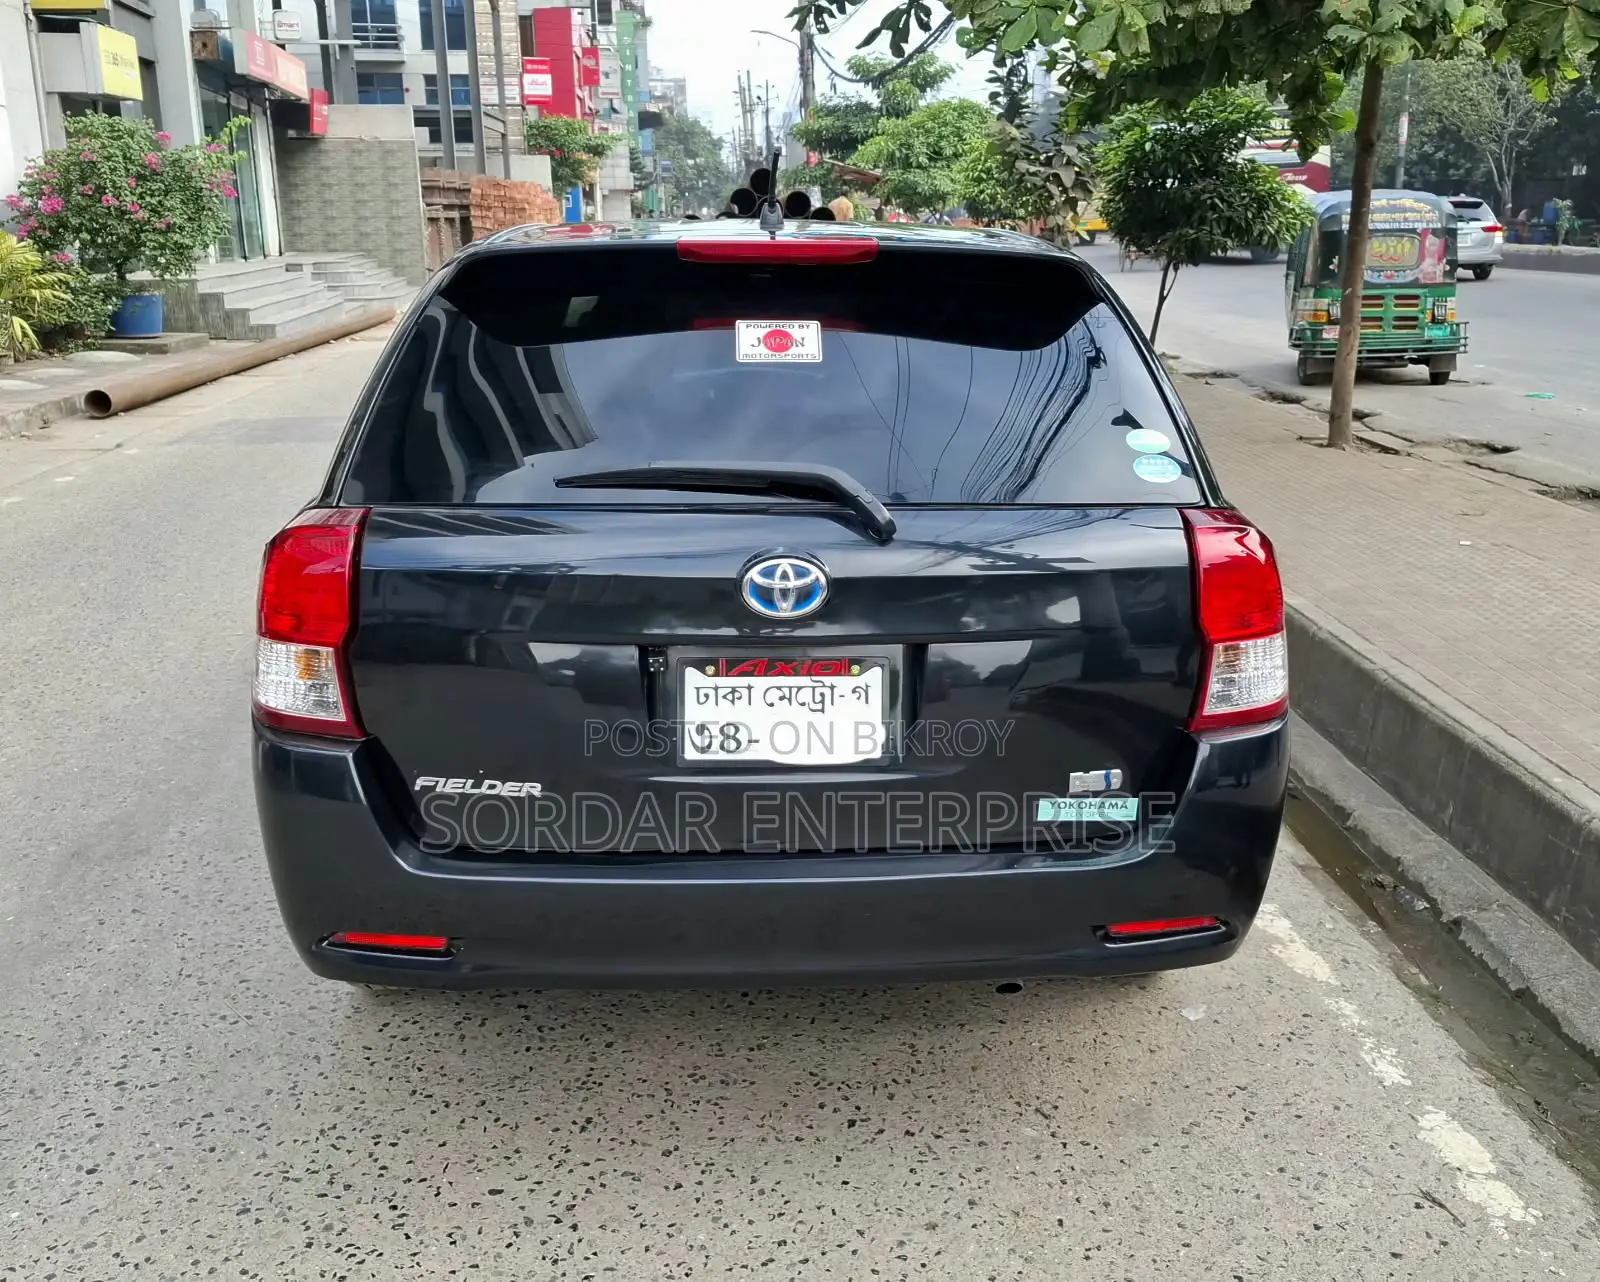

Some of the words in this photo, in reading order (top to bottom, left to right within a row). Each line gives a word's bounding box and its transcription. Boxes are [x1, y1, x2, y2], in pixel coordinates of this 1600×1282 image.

[749, 336, 806, 348] JAPAN
[727, 658, 842, 676] Axio
[694, 683, 754, 706] ঢাকা
[414, 776, 543, 798] FIELDER
[1049, 800, 1129, 810] YOKOHAMA
